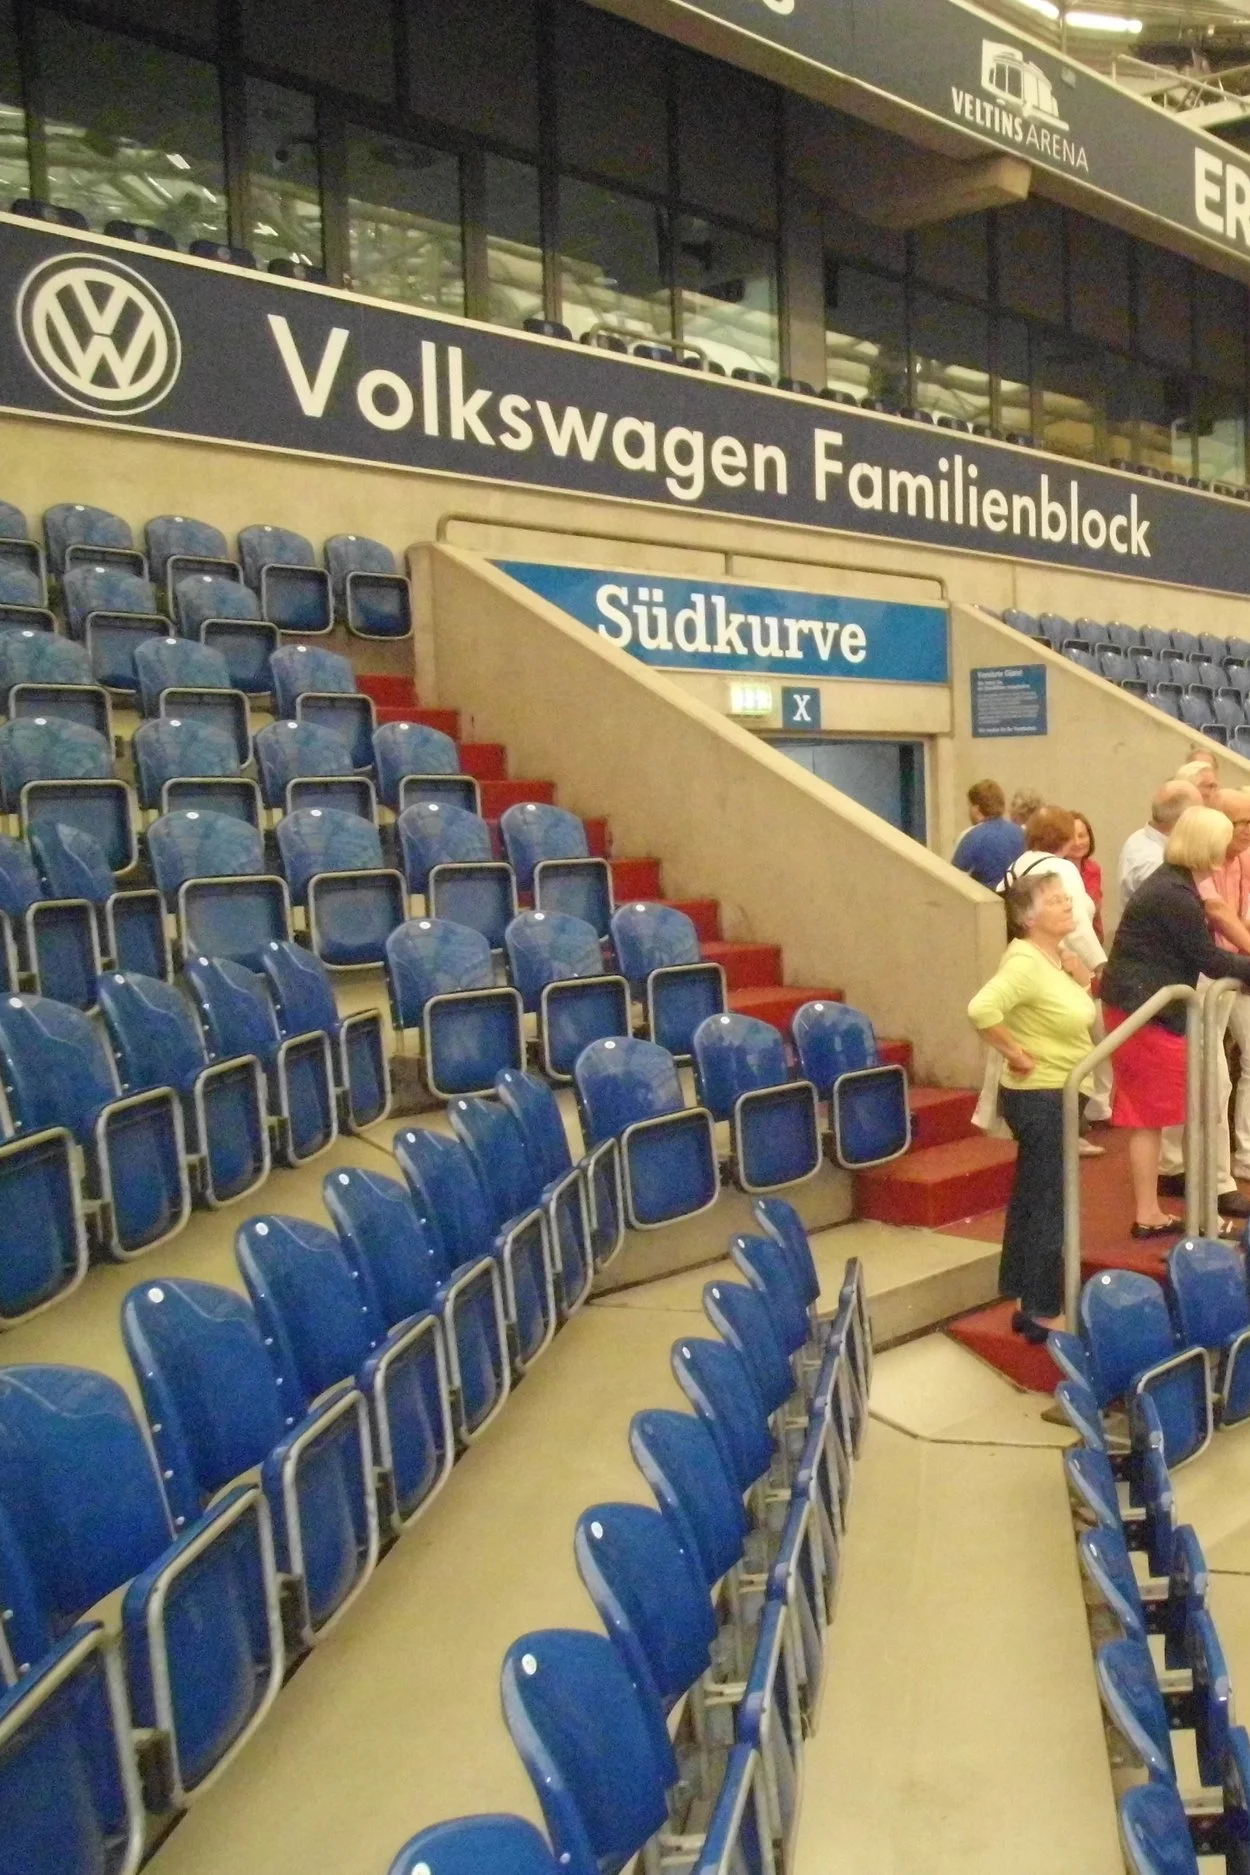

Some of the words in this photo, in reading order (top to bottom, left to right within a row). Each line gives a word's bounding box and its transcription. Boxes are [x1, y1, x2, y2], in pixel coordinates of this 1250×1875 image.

[951, 86, 1023, 142] VELTINS
[1026, 124, 1089, 172] ARENA
[267, 314, 788, 500] Volkswagen
[813, 428, 1151, 557] Familienblock
[595, 584, 867, 663] Südkurve
[793, 694, 812, 721] X
